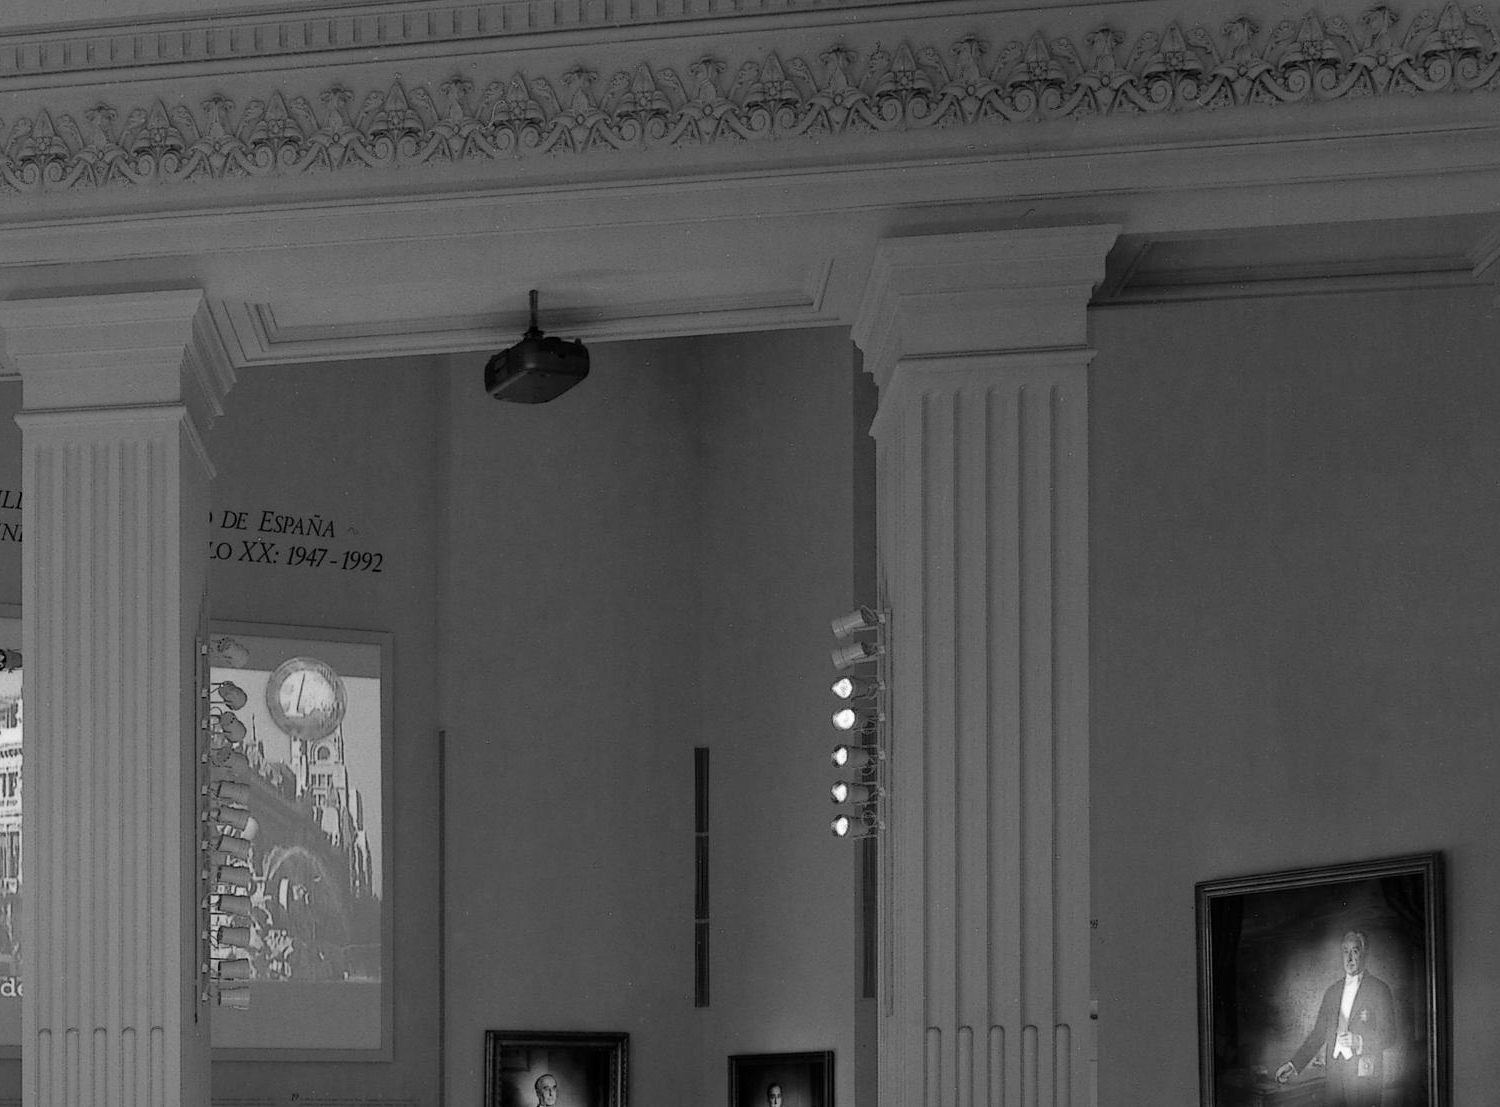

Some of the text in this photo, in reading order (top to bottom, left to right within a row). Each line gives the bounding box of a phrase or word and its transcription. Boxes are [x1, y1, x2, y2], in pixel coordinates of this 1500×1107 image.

[220, 510, 249, 530] DE
[258, 510, 335, 538] ESPAÑA
[238, 540, 280, 564] XX:
